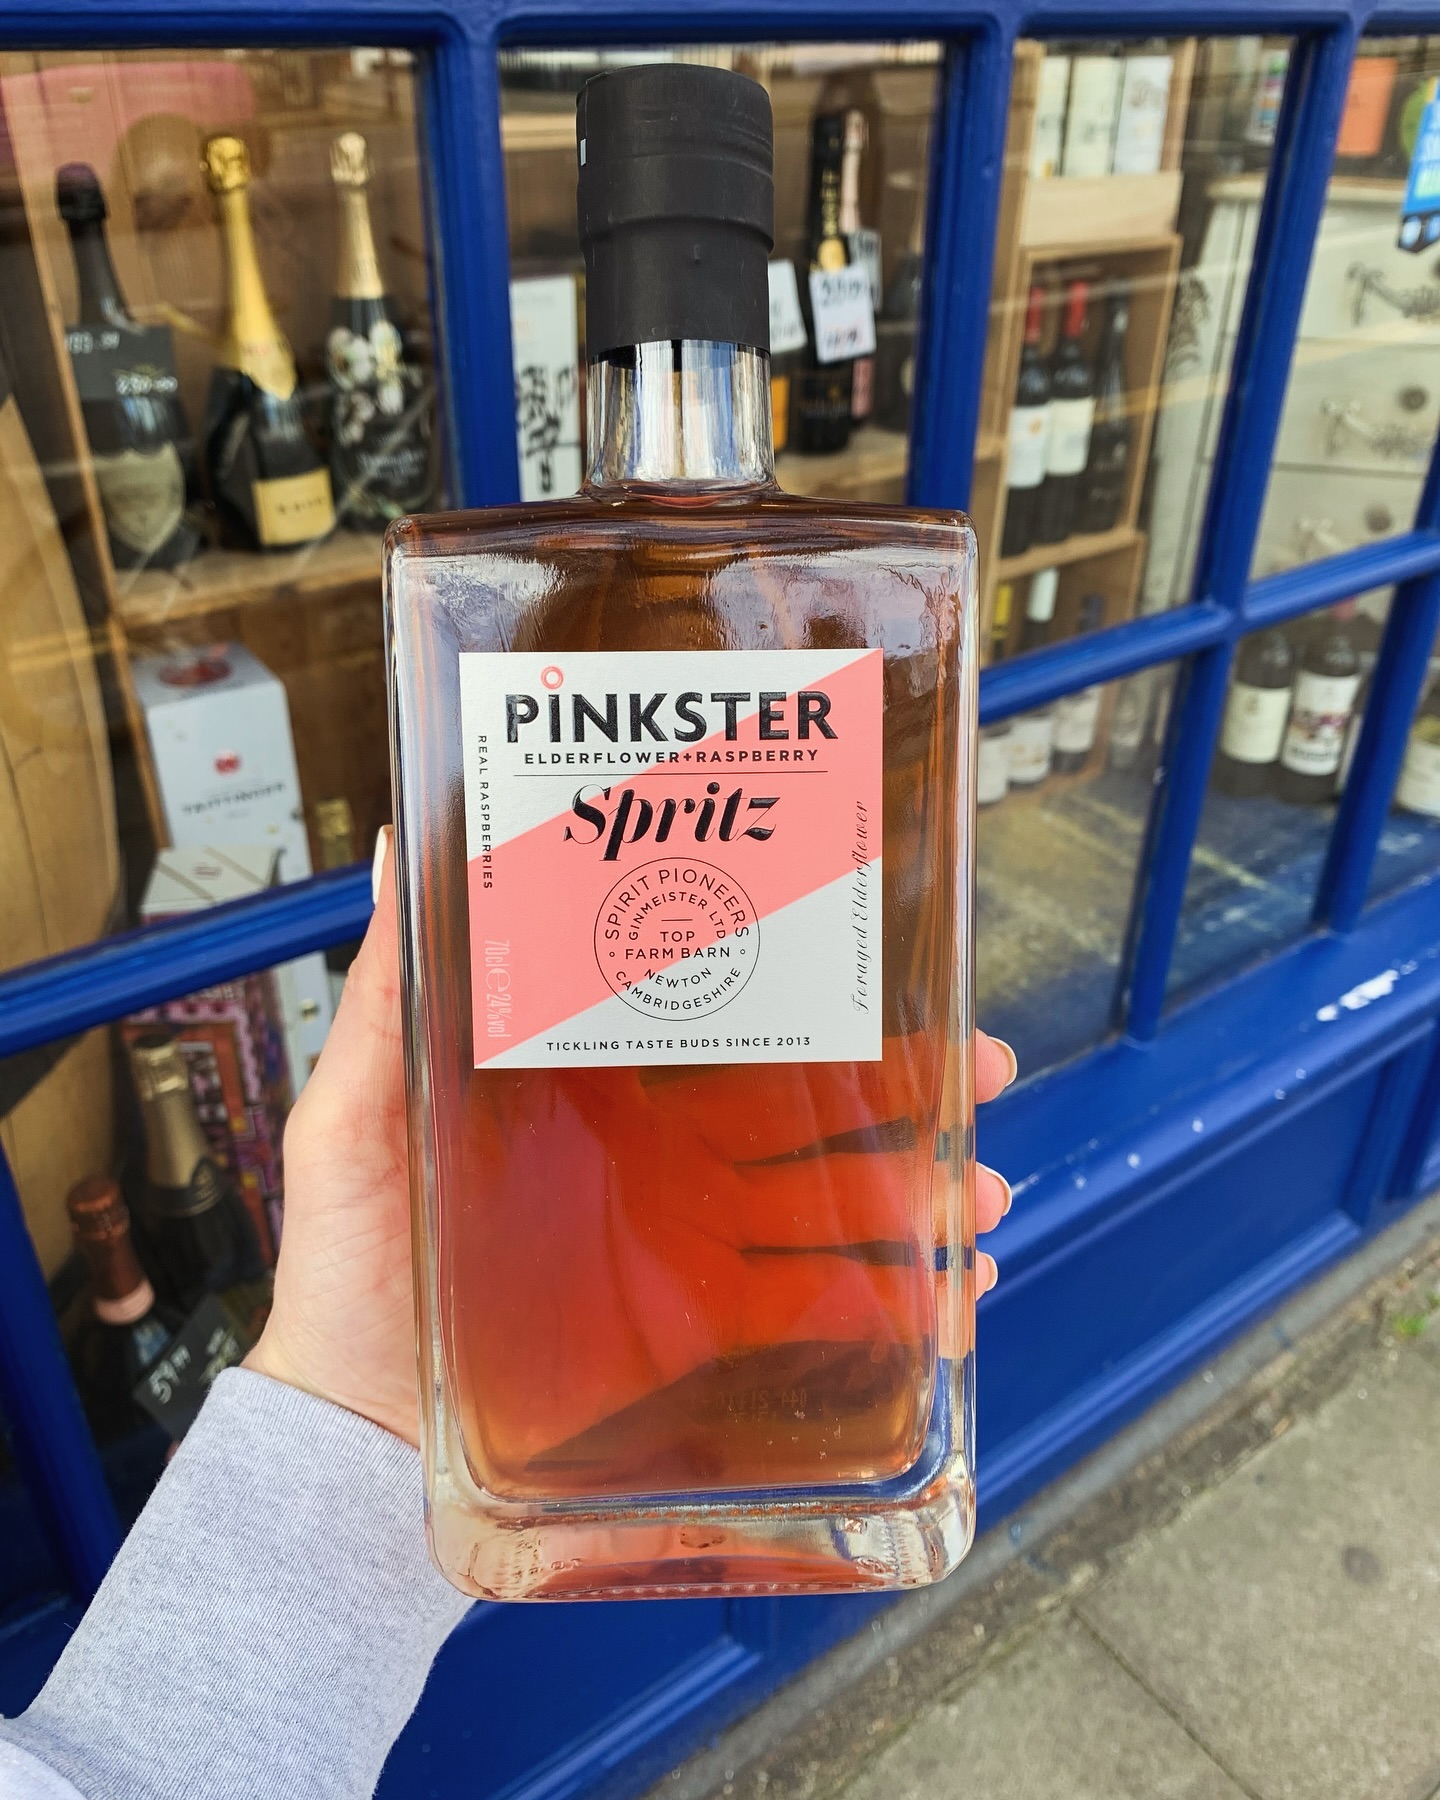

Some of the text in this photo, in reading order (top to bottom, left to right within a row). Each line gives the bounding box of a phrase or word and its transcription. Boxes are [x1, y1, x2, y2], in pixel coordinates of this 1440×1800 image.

[477, 735, 493, 889] REAL RASPBERRIES
[563, 782, 780, 861] Spritz
[605, 868, 749, 940] SPIRIT PIONEERS
[628, 891, 726, 941] GINMEISTER LTD
[850, 800, 873, 1014] Foraged Elderflower
[625, 946, 730, 959] FARM BARN
[660, 930, 695, 943] TOP
[616, 967, 741, 1011] CAMBRIDGESHIRE
[644, 967, 712, 988] NEWTON
[546, 1036, 811, 1051] TICKLING TASTE BUDS SINCE 2013
